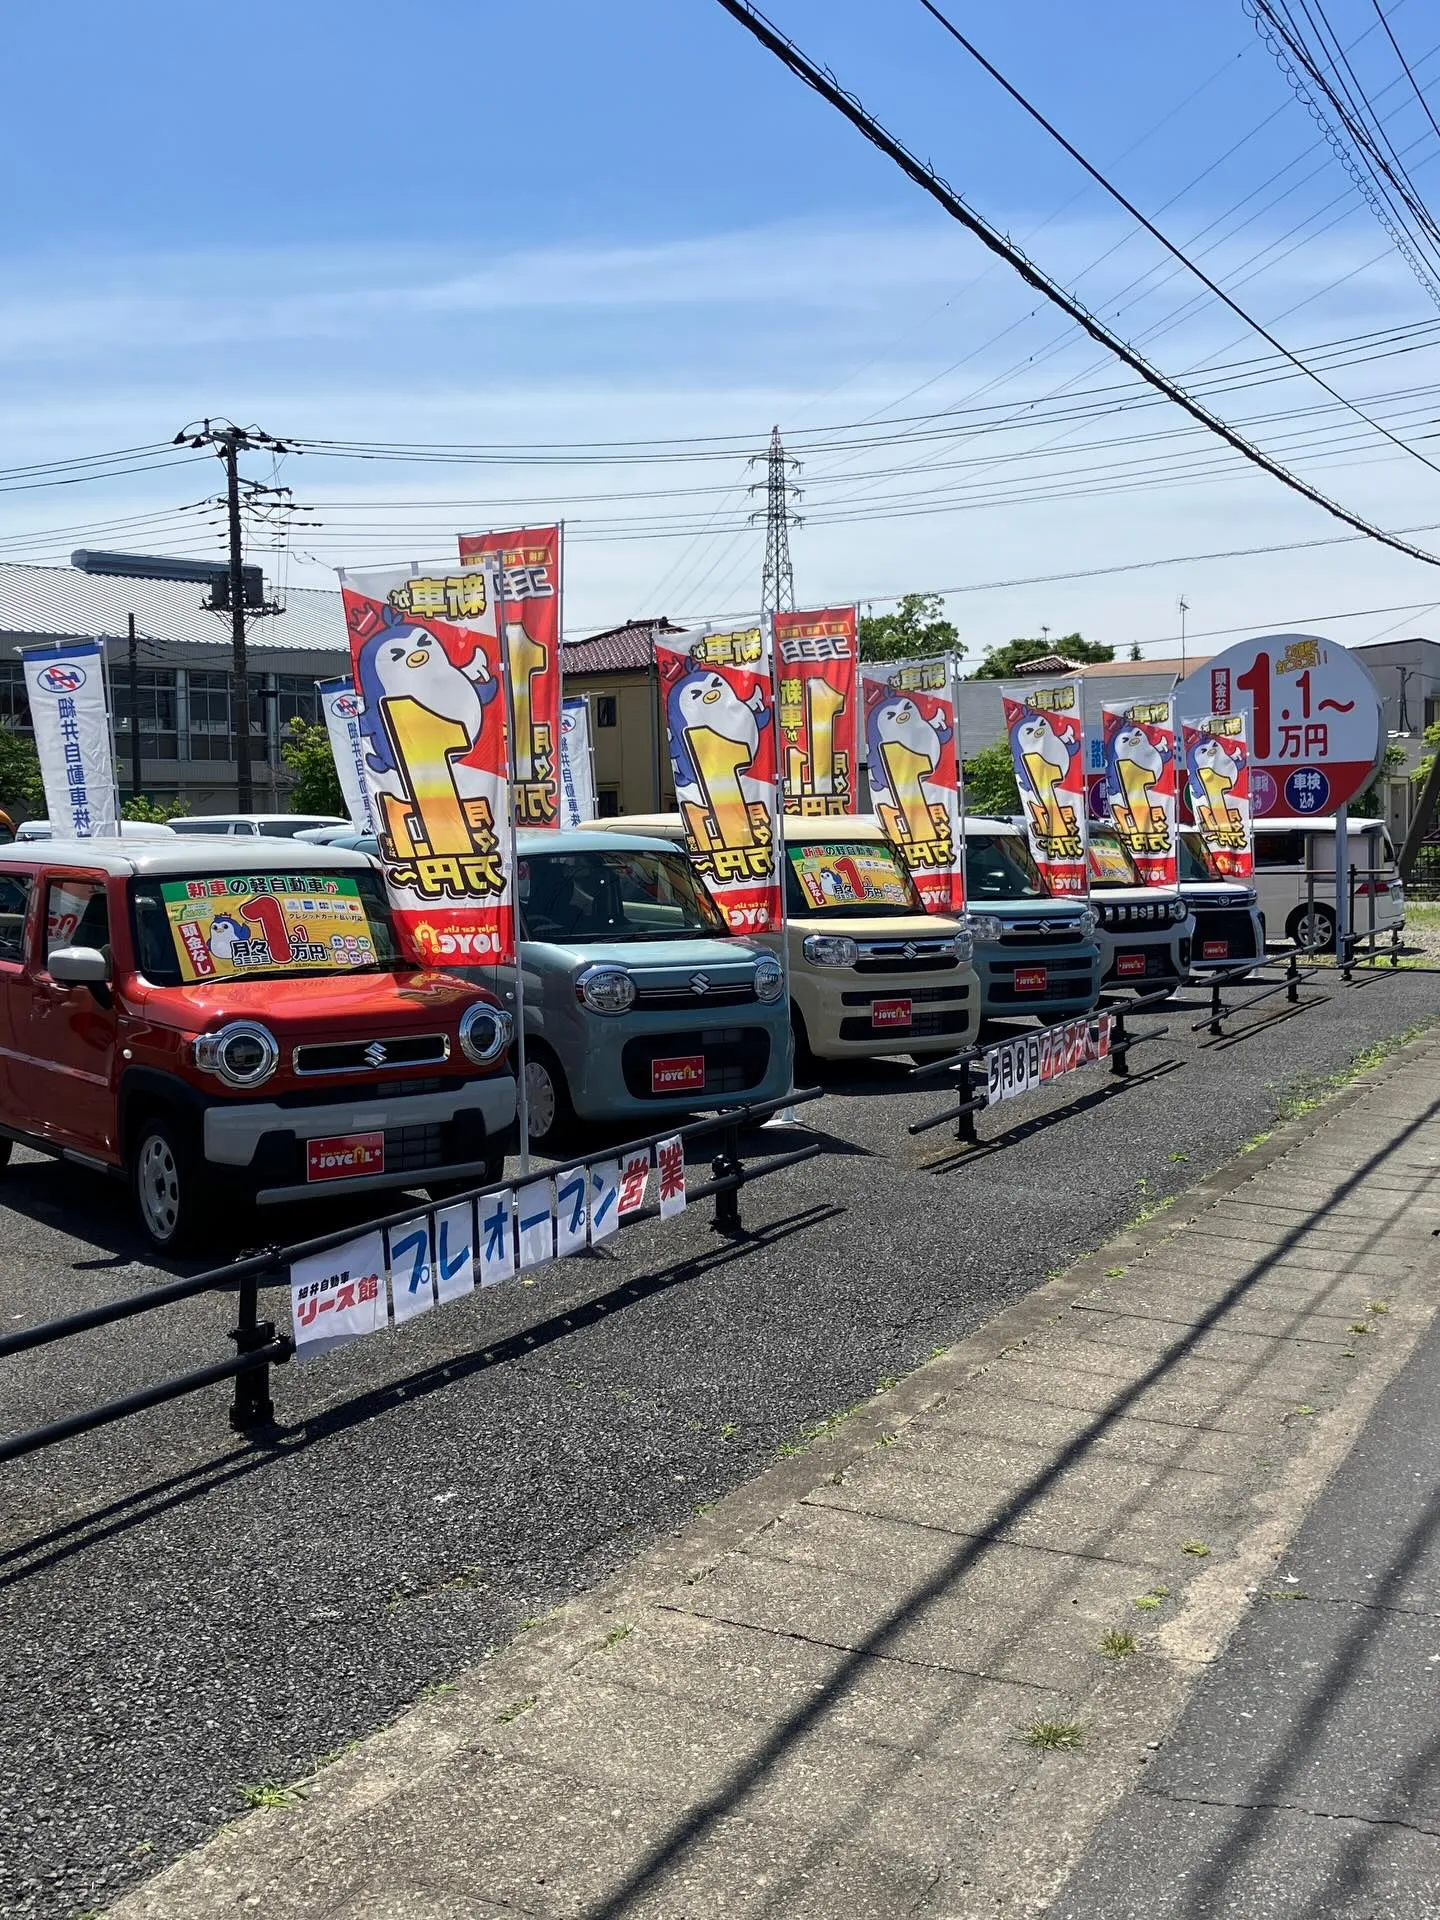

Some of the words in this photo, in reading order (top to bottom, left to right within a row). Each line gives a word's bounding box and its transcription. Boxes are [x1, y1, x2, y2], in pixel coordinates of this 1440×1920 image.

[1214, 671, 1228, 711] 頭金な
[1279, 723, 1328, 759] 万円
[1293, 773, 1321, 790] 車検
[186, 876, 338, 898] 新車の軽自動車が
[182, 924, 211, 974] 頭金なし
[231, 939, 268, 958] 月々
[660, 1065, 697, 1082] JOYCAL
[319, 1145, 374, 1168] JOYCAL
[298, 1271, 350, 1300] 細井自動車
[297, 1274, 378, 1327] リース館
